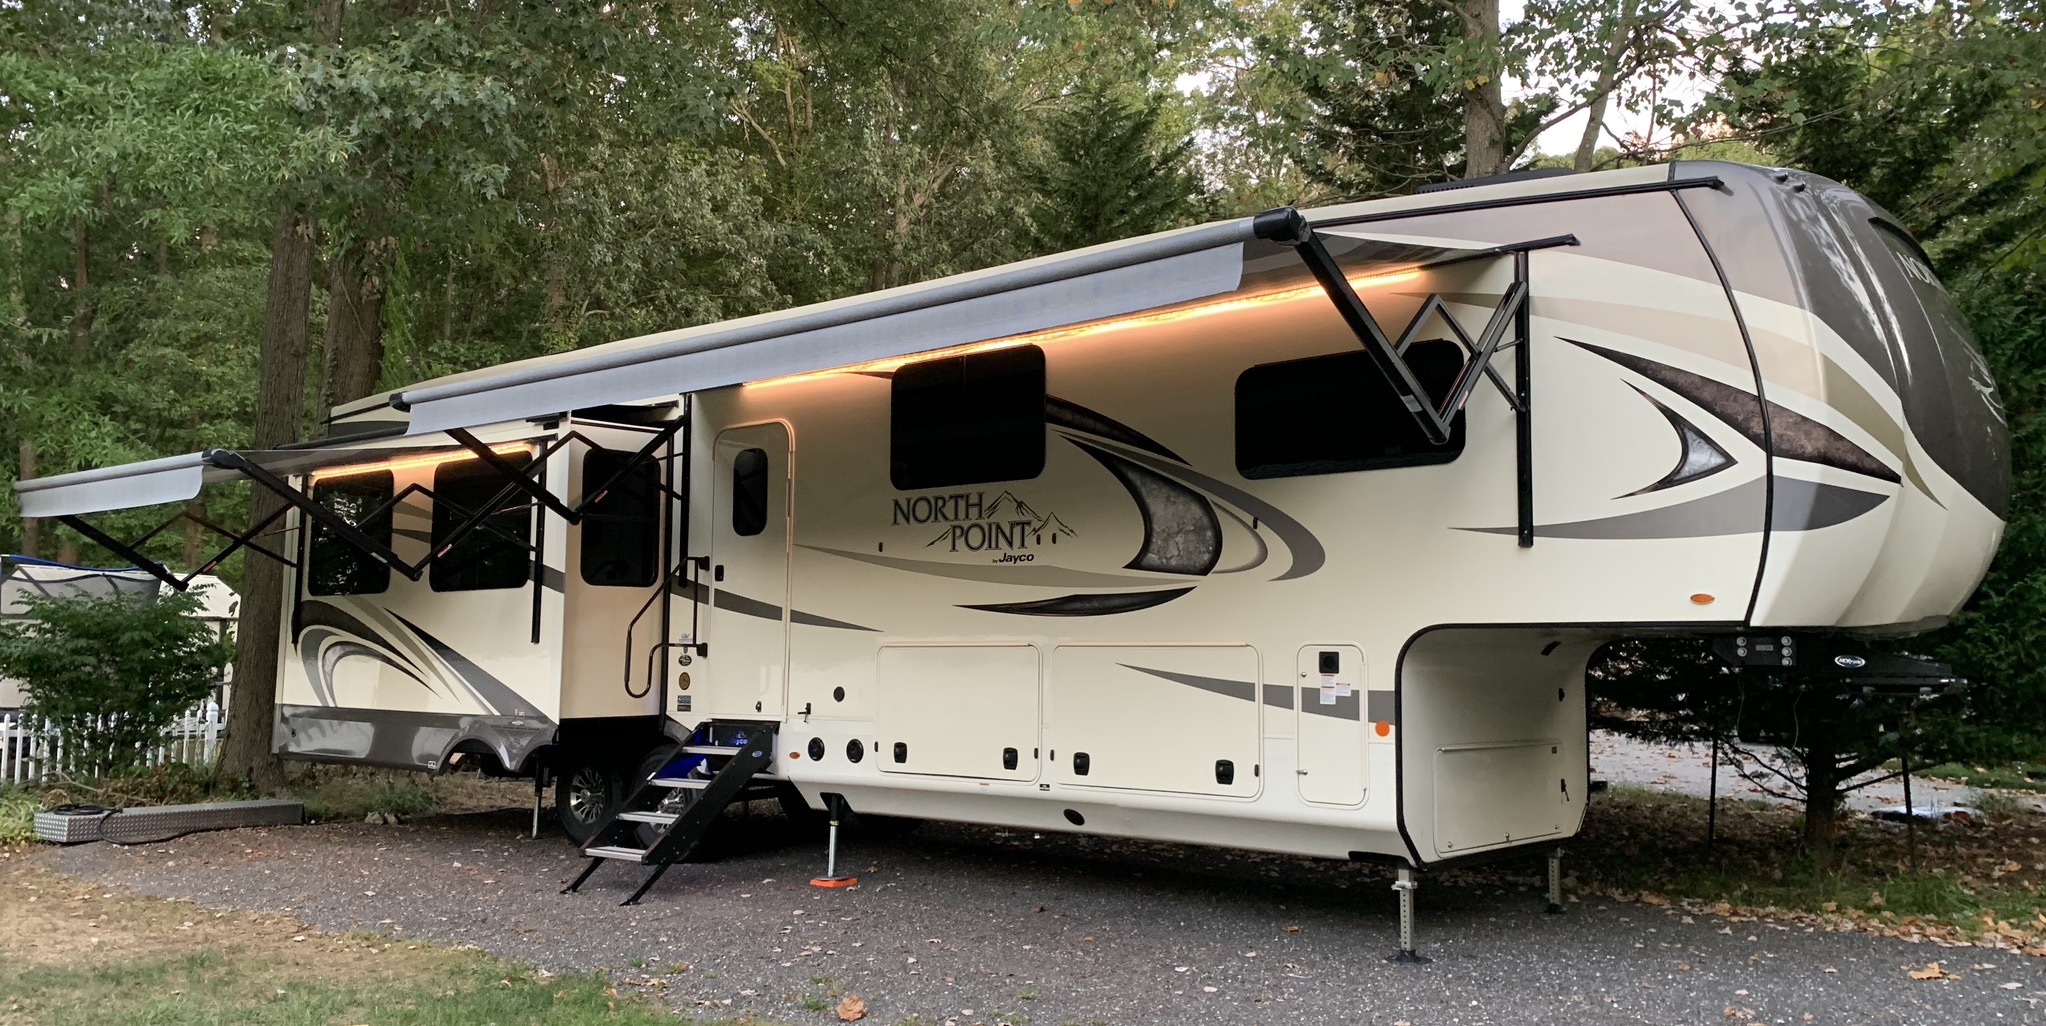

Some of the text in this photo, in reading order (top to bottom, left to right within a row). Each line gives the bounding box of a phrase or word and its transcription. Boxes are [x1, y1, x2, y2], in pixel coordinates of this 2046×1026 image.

[891, 492, 985, 525] NORTH
[949, 520, 1032, 552] POINT
[999, 552, 1034, 564] Jayco
